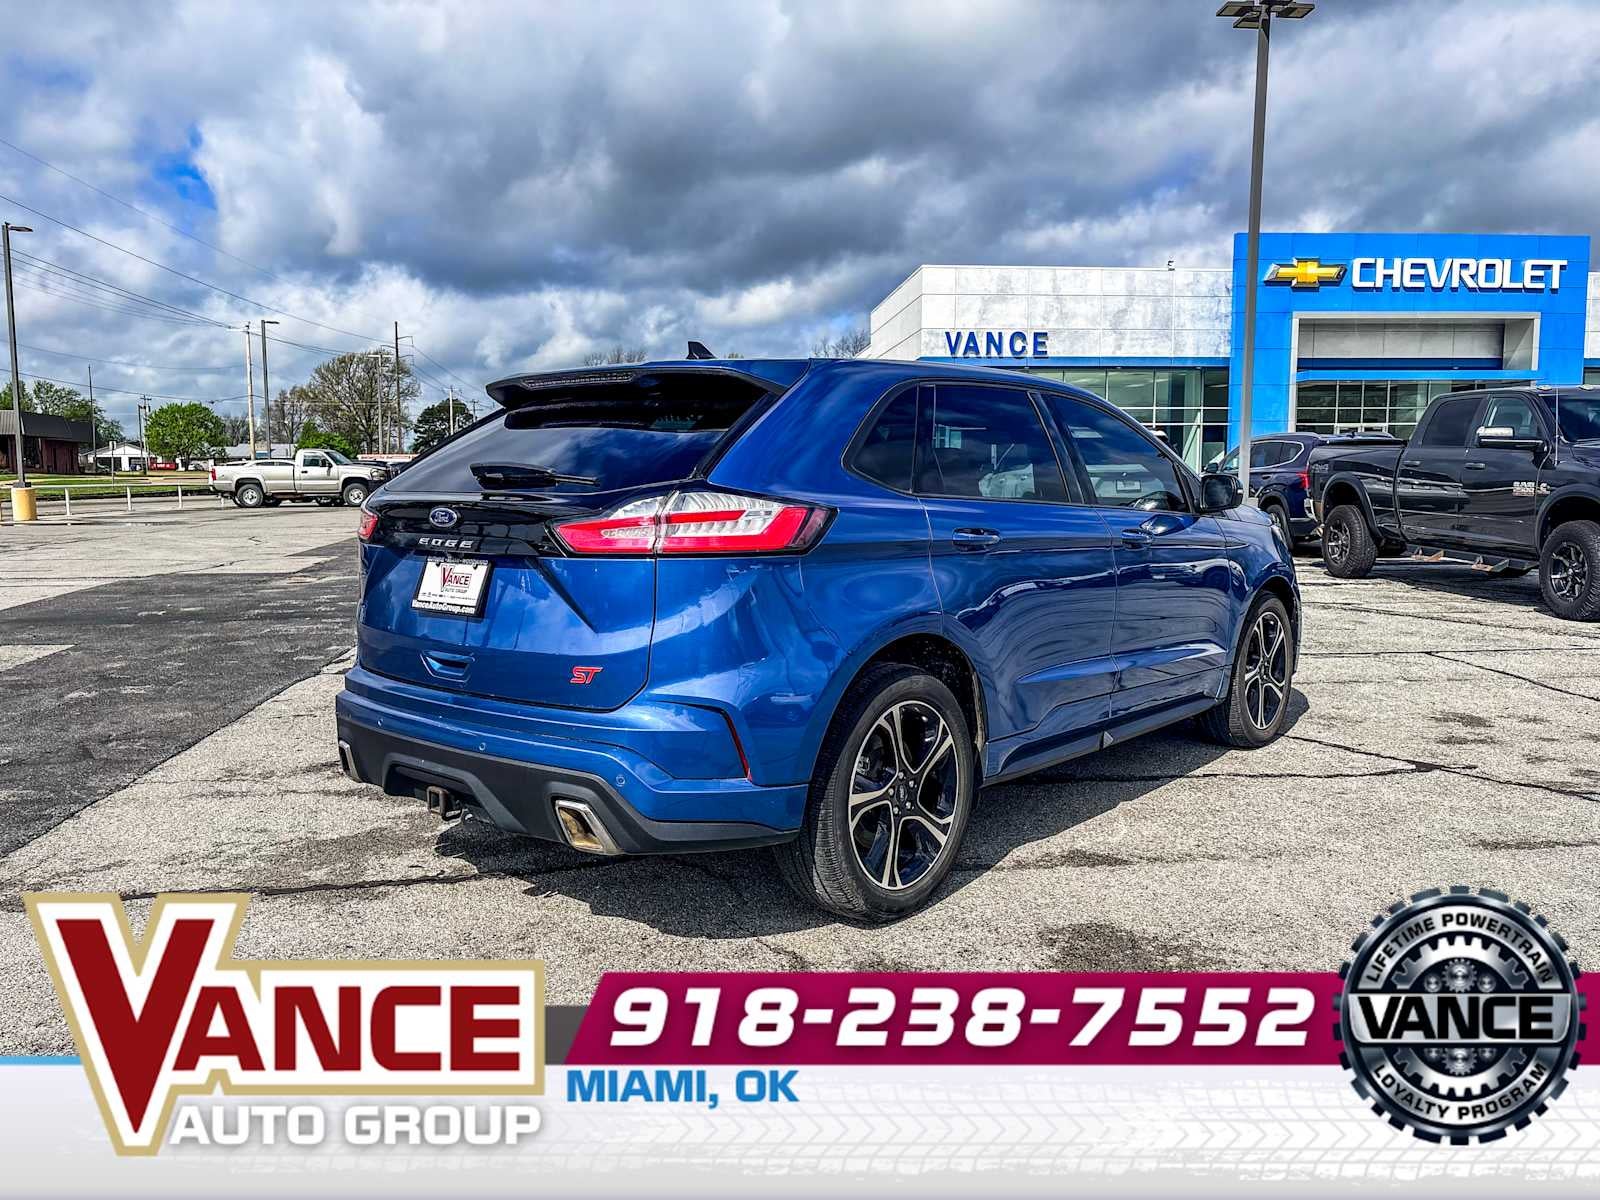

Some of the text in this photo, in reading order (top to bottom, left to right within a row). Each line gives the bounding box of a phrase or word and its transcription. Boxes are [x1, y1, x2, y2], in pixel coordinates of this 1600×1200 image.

[1351, 256, 1568, 291] CHEVROLET
[944, 331, 1049, 359] VANCE
[419, 537, 474, 549] EDGE
[442, 567, 471, 588] VANCE
[570, 666, 603, 685] ST
